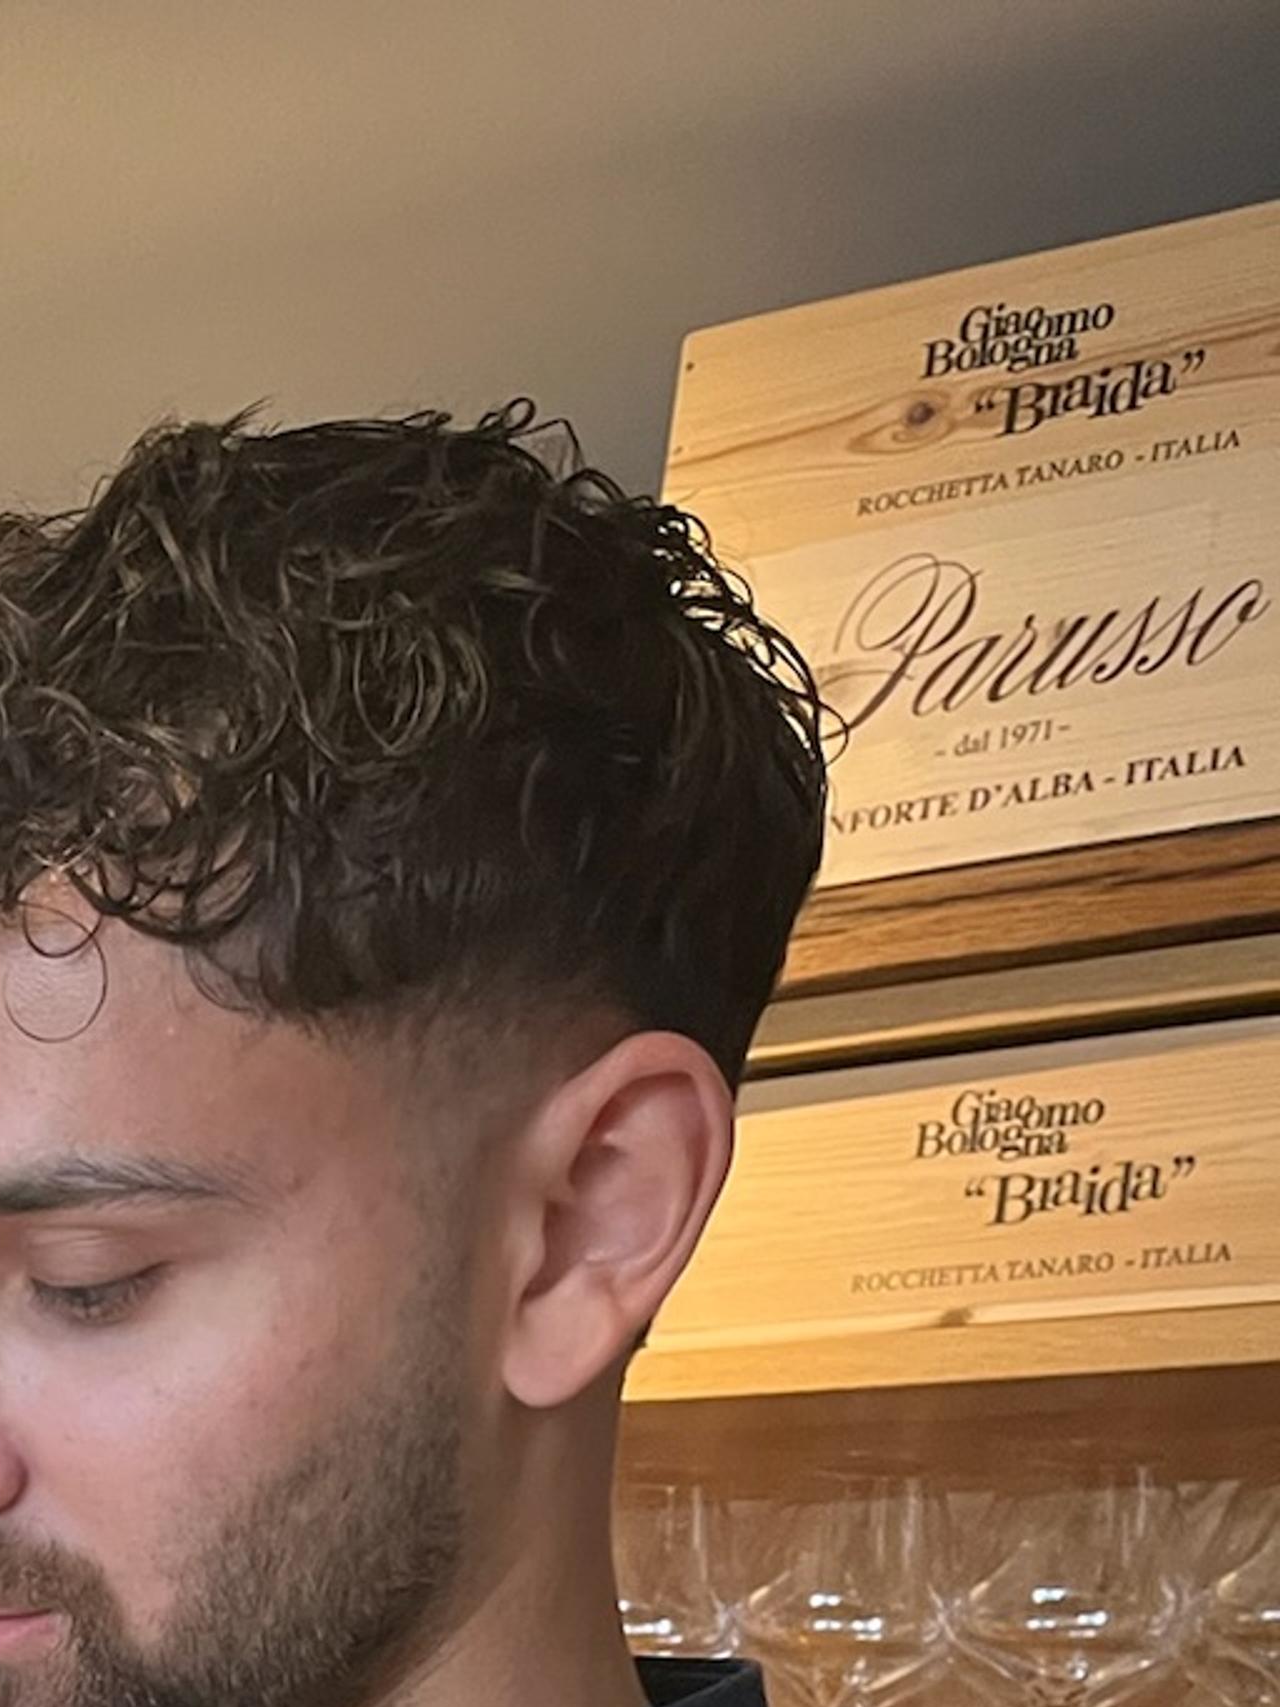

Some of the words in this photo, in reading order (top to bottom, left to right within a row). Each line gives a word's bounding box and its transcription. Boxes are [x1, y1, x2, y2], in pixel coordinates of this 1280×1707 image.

[959, 302, 1115, 345] Giacomo
[921, 334, 1080, 379] Bologna
[856, 470, 1010, 517] ROCCHETTA
[1016, 450, 1124, 489] TANARO
[1151, 429, 1240, 463] ITALIA
[820, 552, 1271, 739] Parusso
[953, 732, 990, 758] dal
[830, 790, 960, 835] NFORTE
[1124, 746, 1248, 788] ITALIA
[951, 1090, 1105, 1129] Giacomo
[915, 1121, 1069, 1160] Bologna
[850, 1263, 999, 1294] ROCCHETTA
[1007, 1252, 1114, 1282] TANARO
[1141, 1242, 1233, 1269] ITALIA
